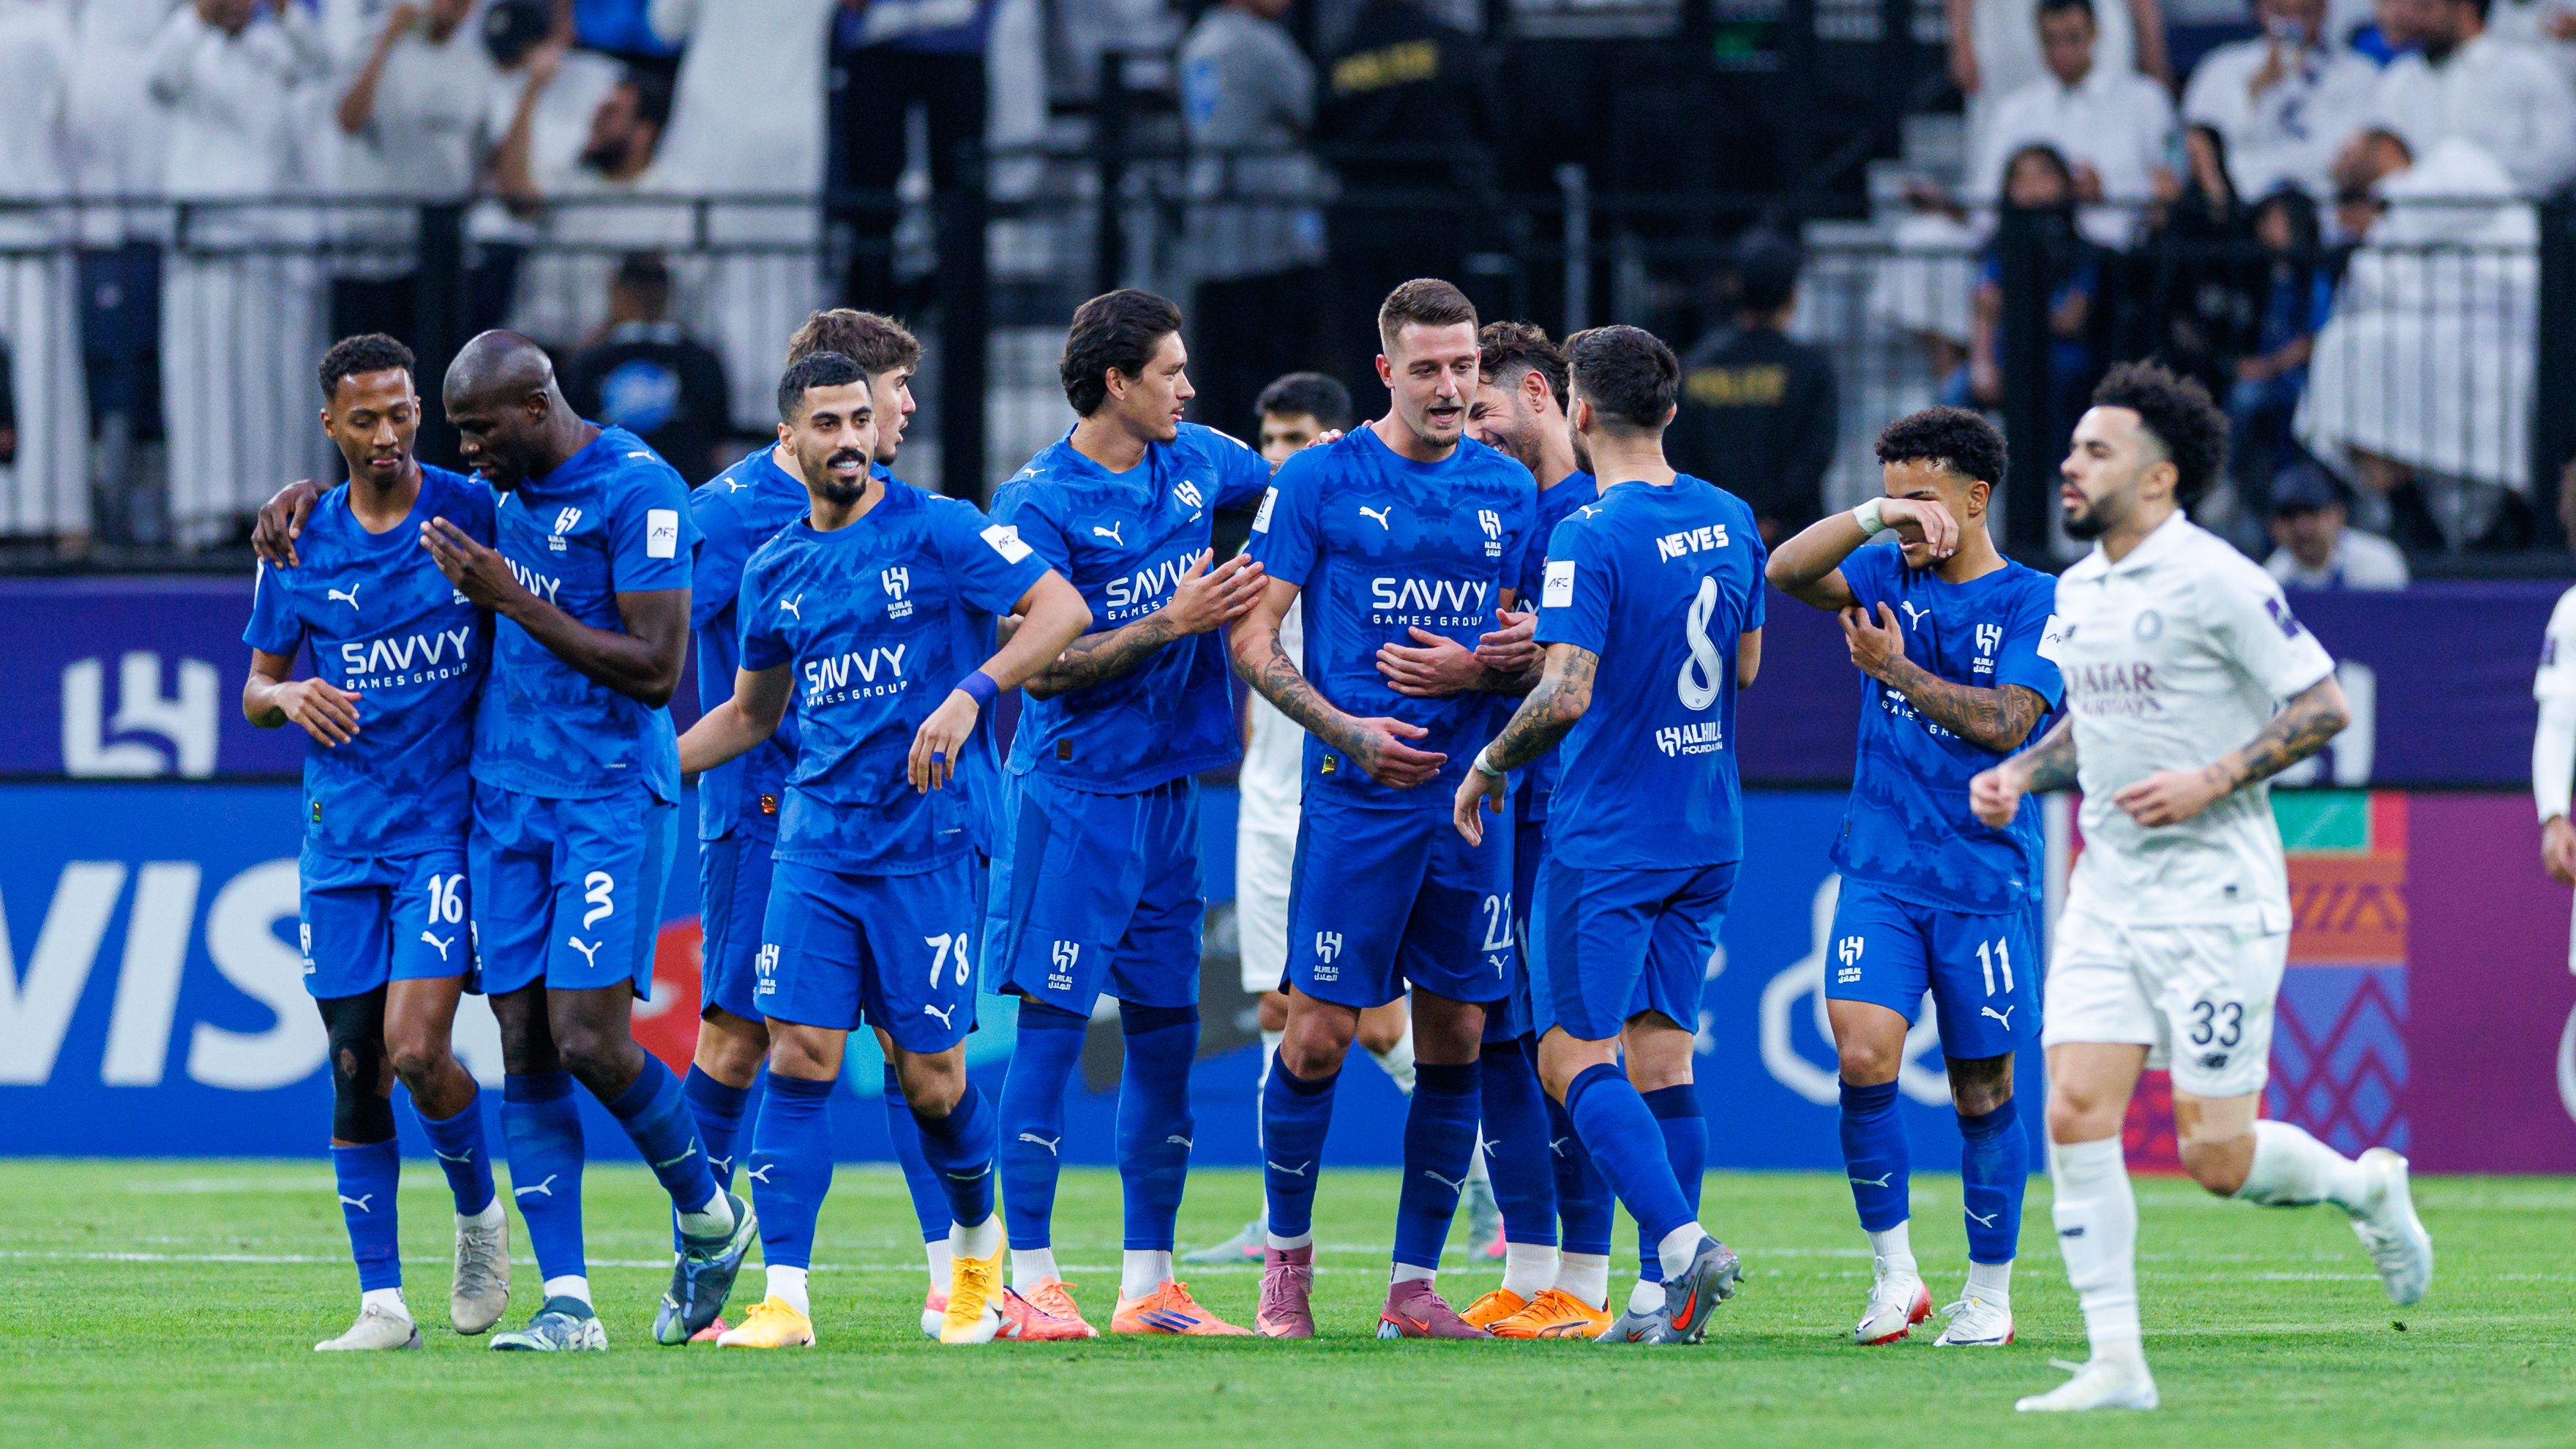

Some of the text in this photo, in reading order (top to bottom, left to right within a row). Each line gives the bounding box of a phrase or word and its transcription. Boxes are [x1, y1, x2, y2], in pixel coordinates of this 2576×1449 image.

[1656, 524, 1729, 564] NEVES
[1372, 577, 1487, 612] SAVVY
[1548, 577, 1568, 588] AFC
[1108, 601, 1161, 621] GAMES
[1373, 615, 1431, 625] GAMES
[342, 626, 470, 675] SAVVY
[1678, 576, 1723, 711] 8
[346, 662, 468, 690] GAMES GROUP
[805, 643, 906, 694] SAVVY
[852, 681, 907, 700] GROUP
[427, 874, 466, 924] 16
[585, 871, 615, 930] 3
[0, 858, 506, 1090] VIS
[924, 932, 970, 990] 78
[1975, 936, 2014, 997] 11
[2190, 1000, 2243, 1047] 33
